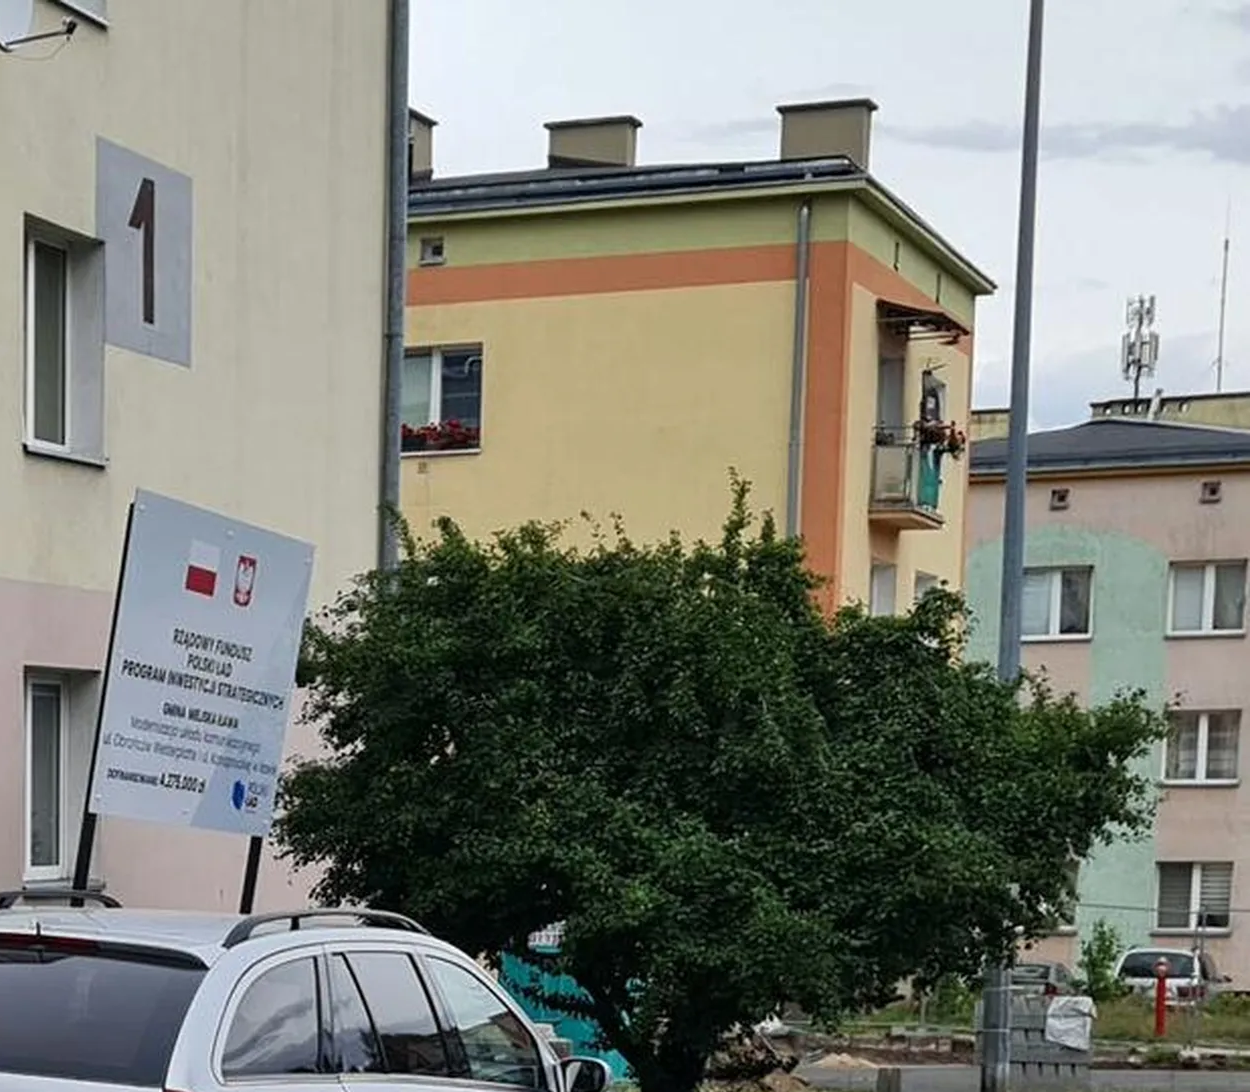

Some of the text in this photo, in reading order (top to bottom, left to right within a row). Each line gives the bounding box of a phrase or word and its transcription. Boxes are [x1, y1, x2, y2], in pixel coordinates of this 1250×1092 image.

[128, 177, 155, 325] 1
[173, 628, 253, 662] RZĄDOWY FUNDUSZ
[121, 659, 166, 684] PROGRAM
[166, 669, 216, 696] INWESTYCJI
[186, 653, 215, 675] POLSKI
